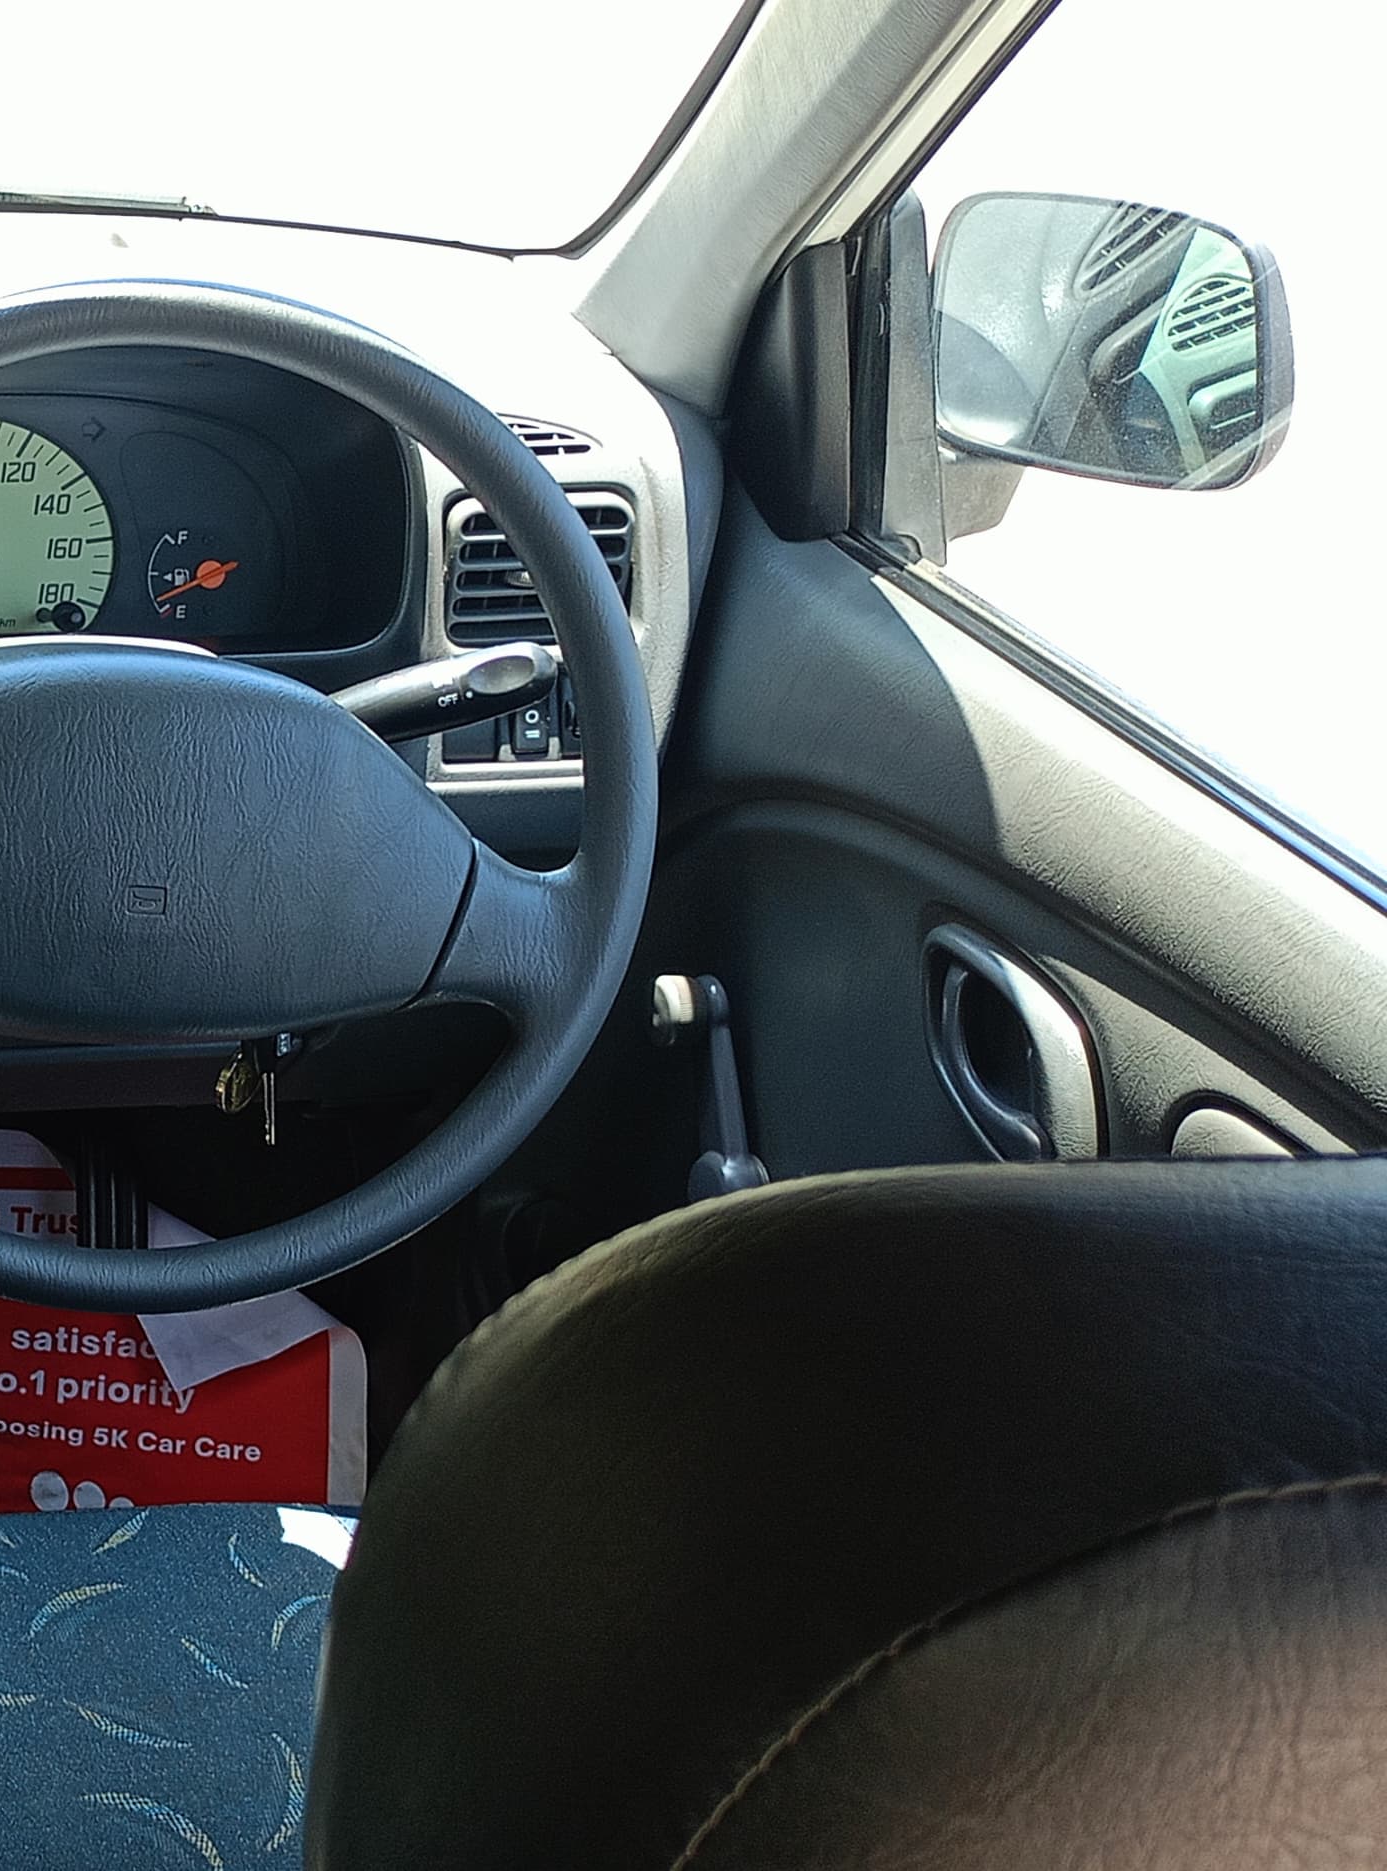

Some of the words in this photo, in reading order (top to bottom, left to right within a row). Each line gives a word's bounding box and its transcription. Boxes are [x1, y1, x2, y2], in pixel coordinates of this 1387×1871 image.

[1, 462, 36, 483] 120
[34, 495, 71, 515] 140
[178, 531, 188, 544] F
[47, 538, 82, 559] 160
[38, 584, 74, 604] 180
[176, 605, 186, 618] E
[0, 618, 16, 628] km
[438, 692, 458, 707] OFF
[11, 1207, 79, 1233] Trus
[11, 1326, 156, 1359] satisfac
[57, 1375, 194, 1414] priority
[93, 1427, 128, 1448] 5K
[137, 1432, 186, 1455] Car
[194, 1437, 261, 1462] Care
